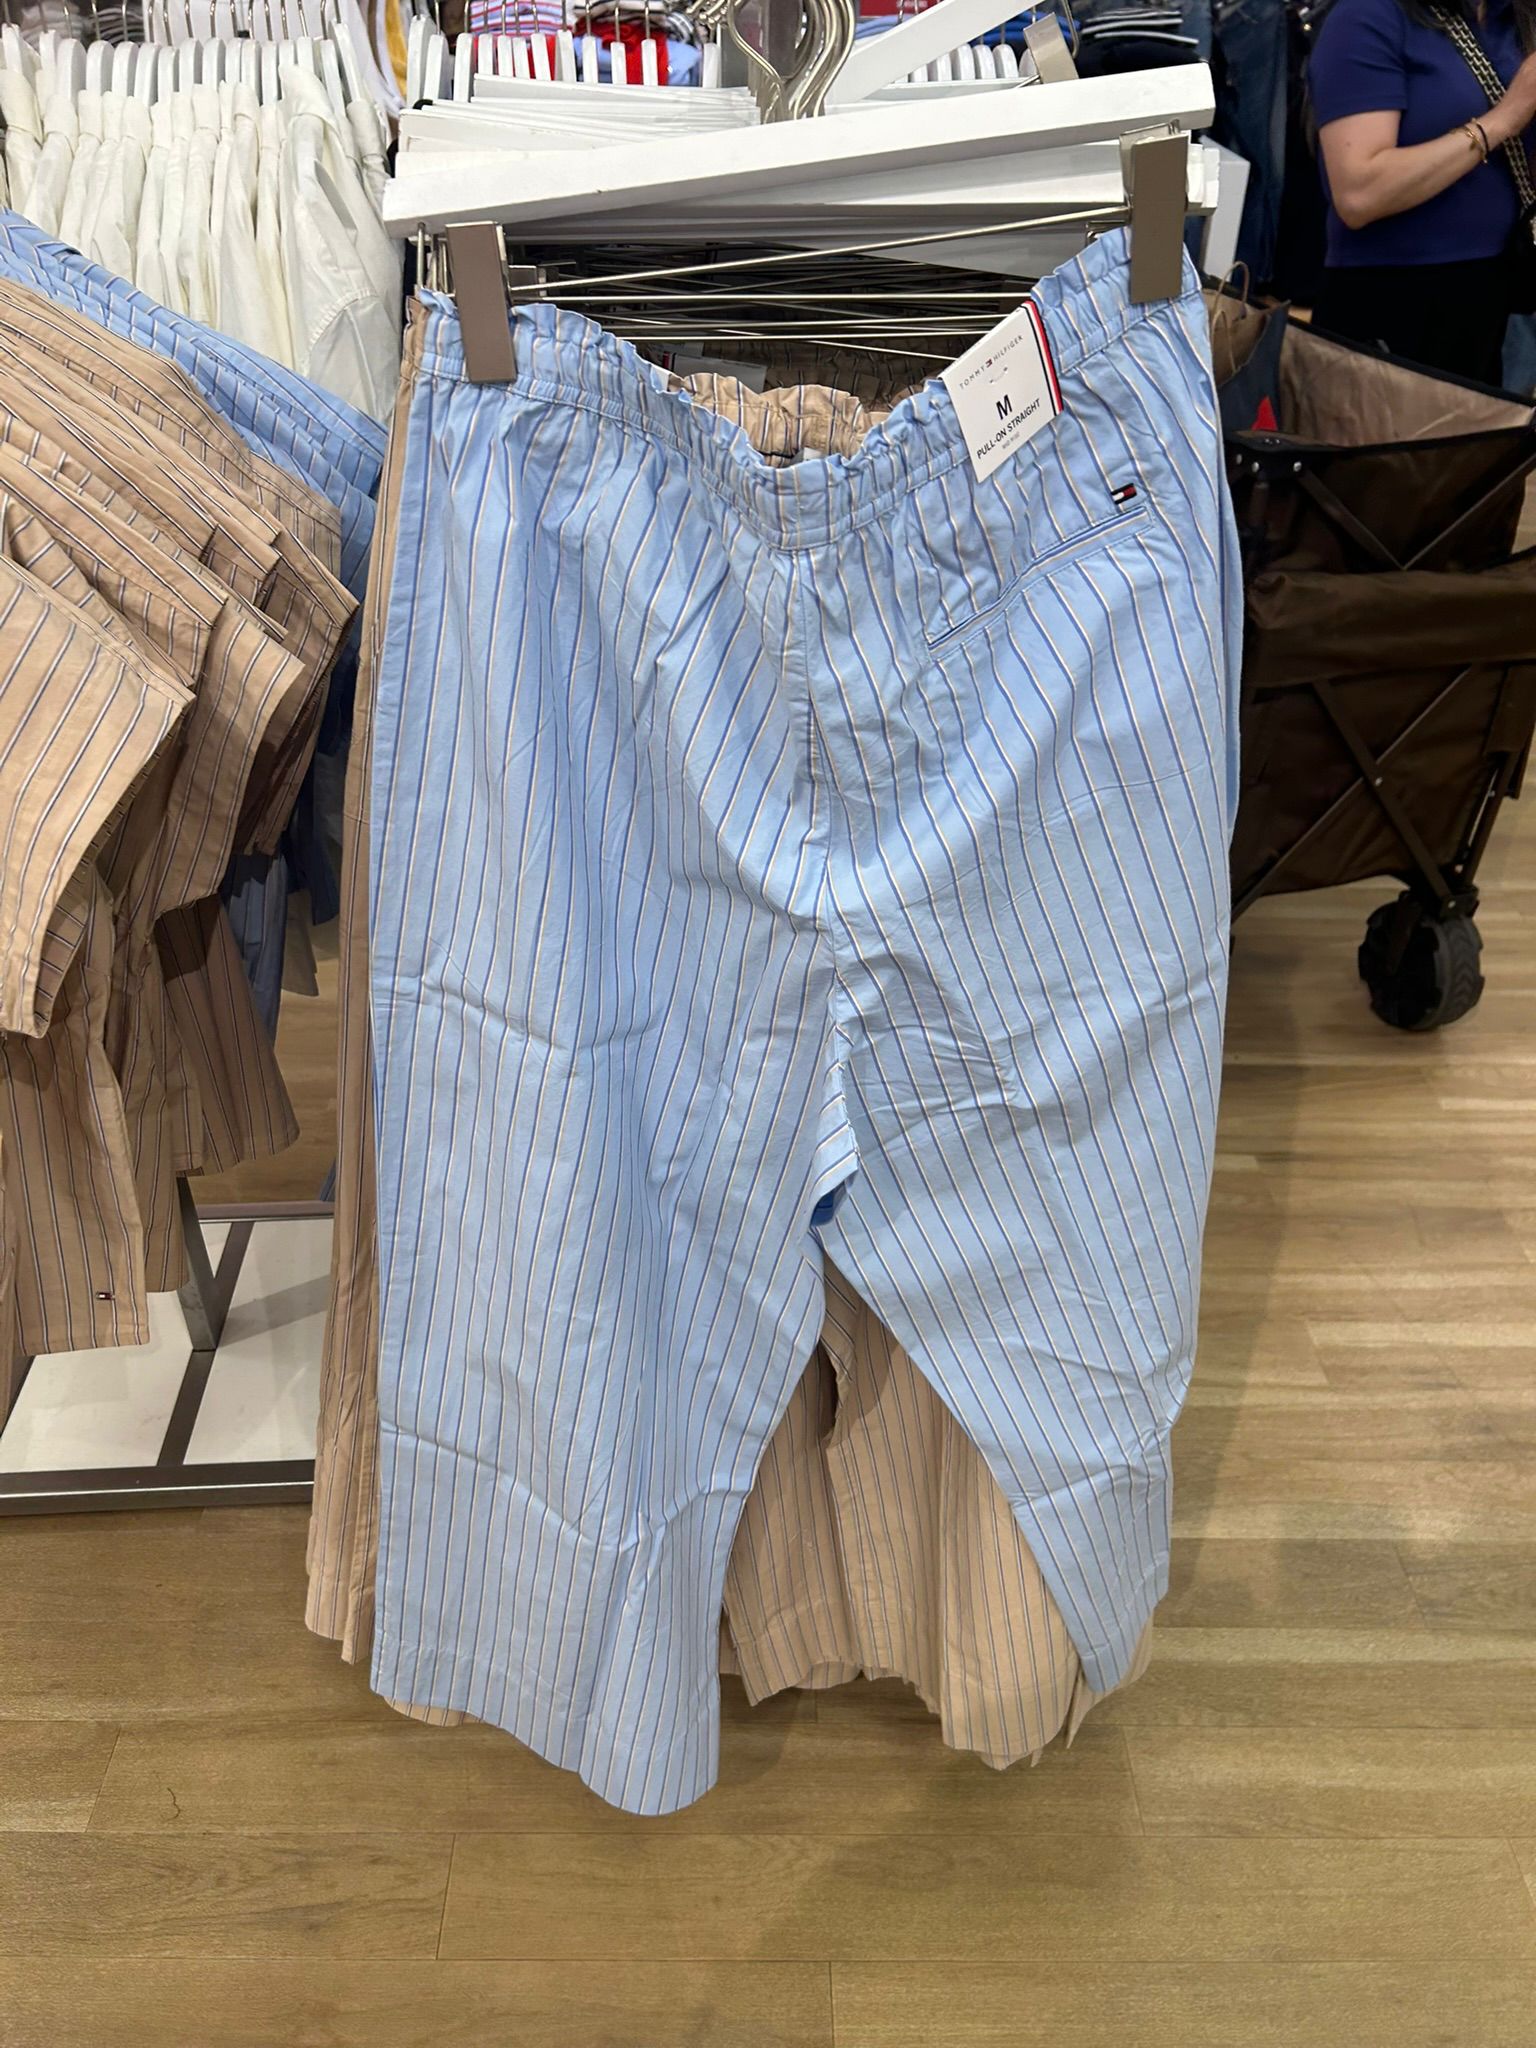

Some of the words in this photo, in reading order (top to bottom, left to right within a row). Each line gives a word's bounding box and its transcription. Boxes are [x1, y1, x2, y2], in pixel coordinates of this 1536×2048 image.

[960, 366, 986, 390] TOMMY
[994, 334, 1024, 363] HILFIGER
[976, 428, 1008, 460] PULL-ON
[1008, 398, 1041, 433] STRAIGHT
[995, 394, 1013, 421] M
